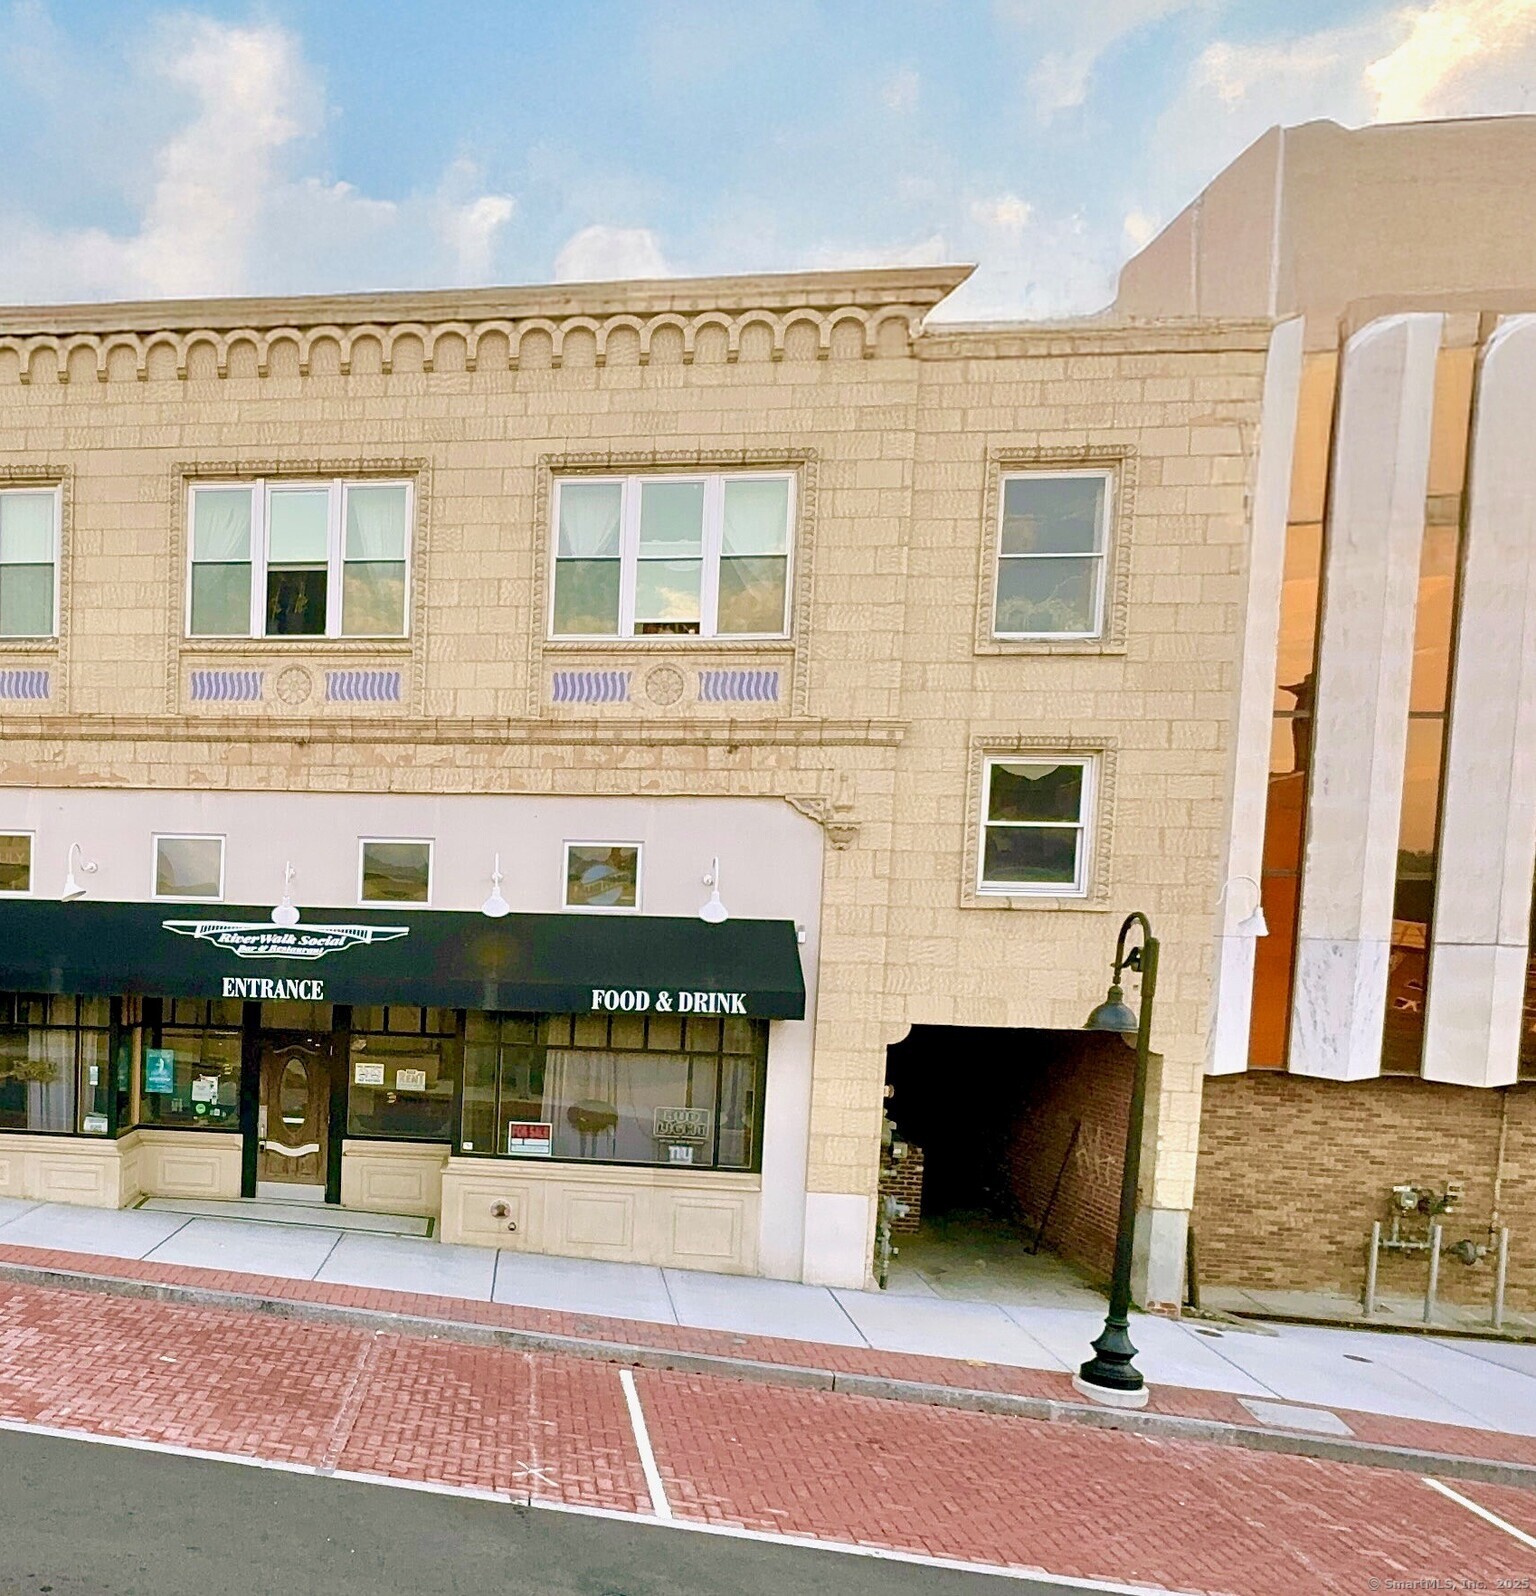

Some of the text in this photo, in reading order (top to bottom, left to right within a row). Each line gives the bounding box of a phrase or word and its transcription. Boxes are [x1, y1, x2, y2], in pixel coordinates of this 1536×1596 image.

[237, 944, 325, 955] Bar & Restaurant
[298, 935, 347, 947] Social
[222, 977, 324, 1000] ENTRANCE
[591, 989, 748, 1014] FOOD & DRINK
